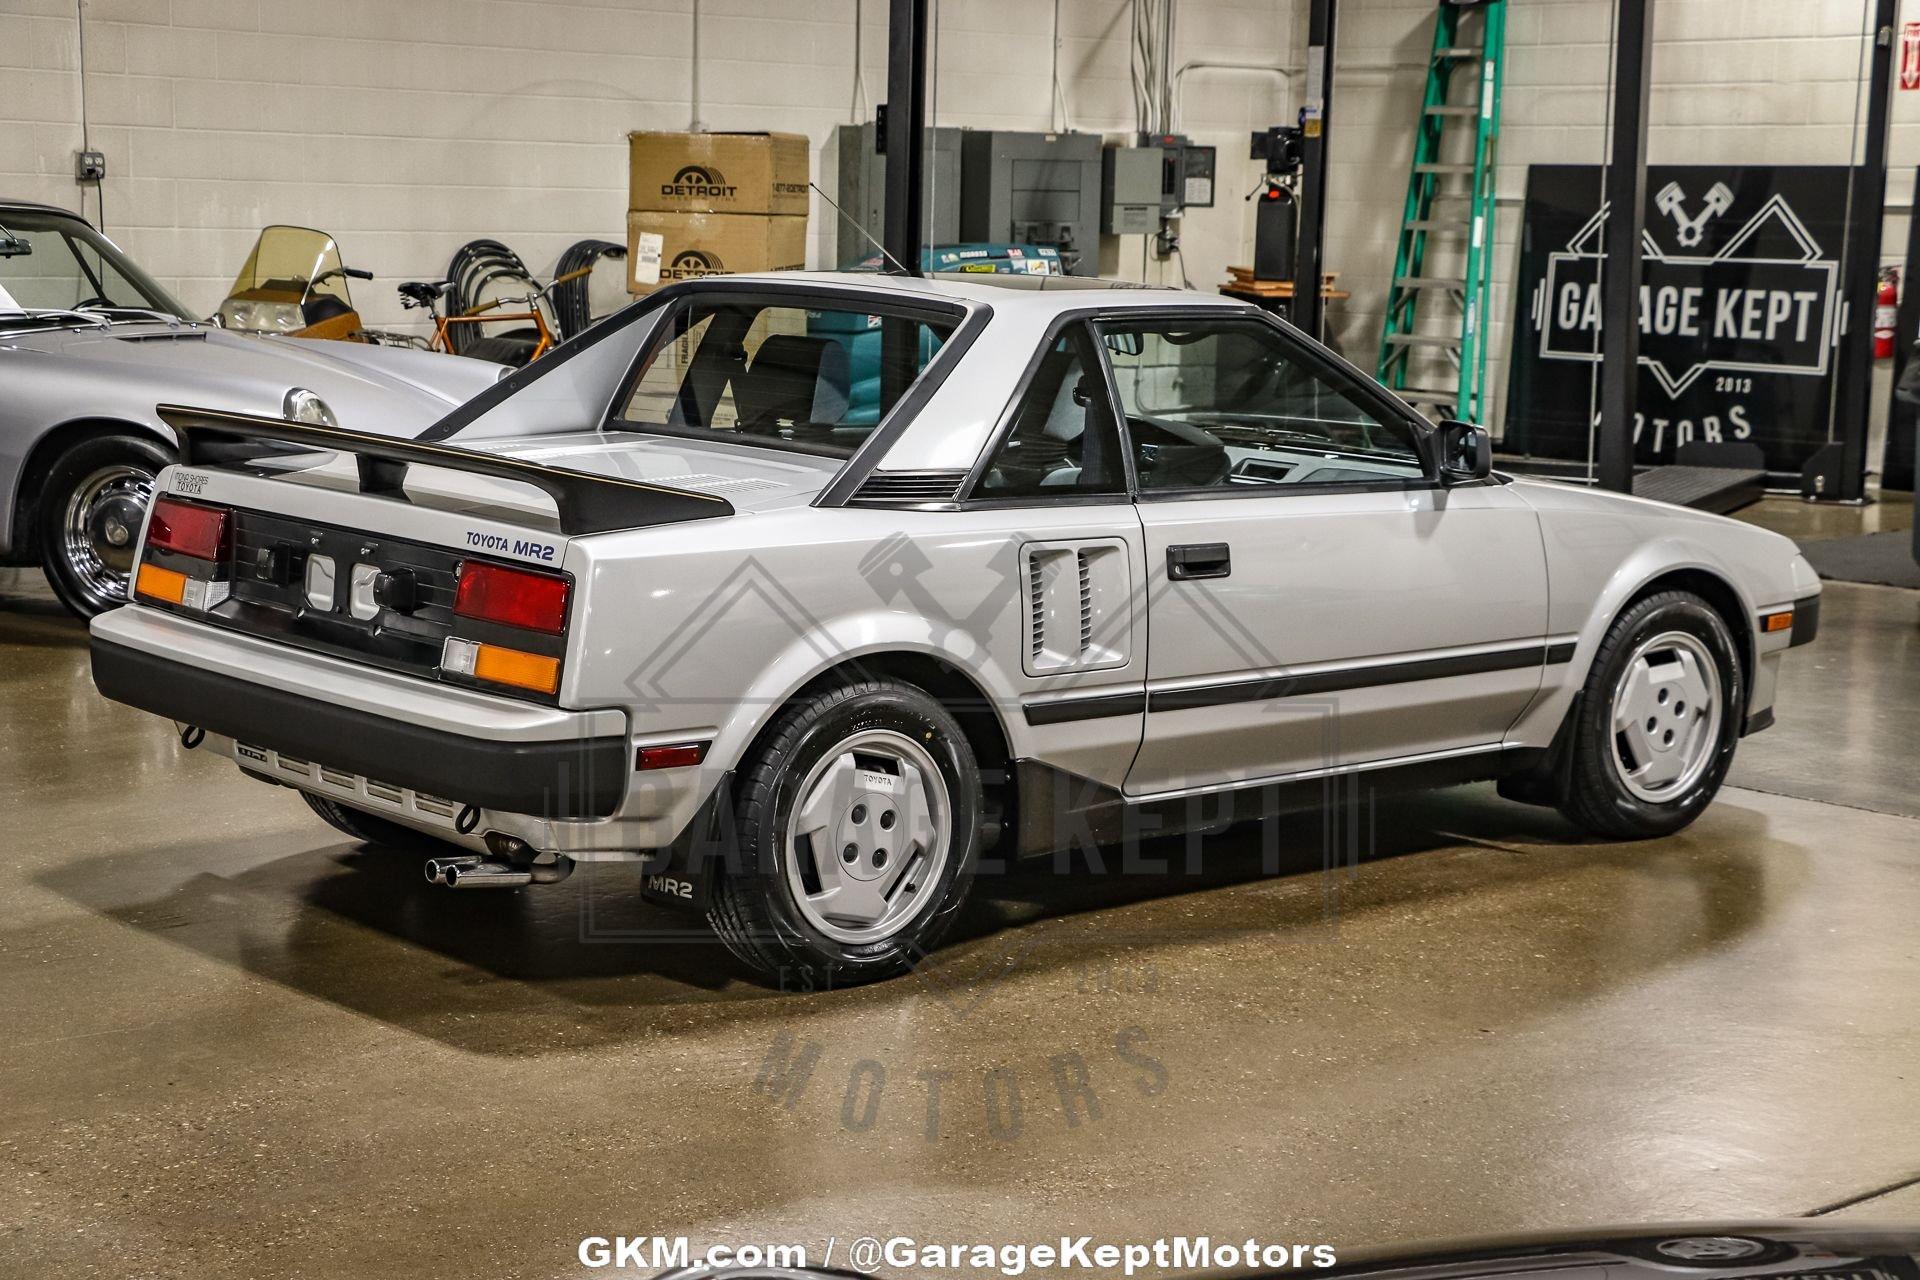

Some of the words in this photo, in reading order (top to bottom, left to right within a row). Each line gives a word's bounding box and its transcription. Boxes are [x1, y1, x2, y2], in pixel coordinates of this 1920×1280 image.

[661, 184, 737, 197] DETROIT
[1557, 282, 1703, 337] GAAGE
[1713, 287, 1818, 343] KEPT
[1715, 376, 1752, 394] 2013
[177, 481, 201, 494] TOYOTA
[466, 531, 508, 552] TOYOTA
[512, 540, 555, 562] MR2
[864, 774, 892, 786] TOYOTA
[648, 875, 693, 899] MR2
